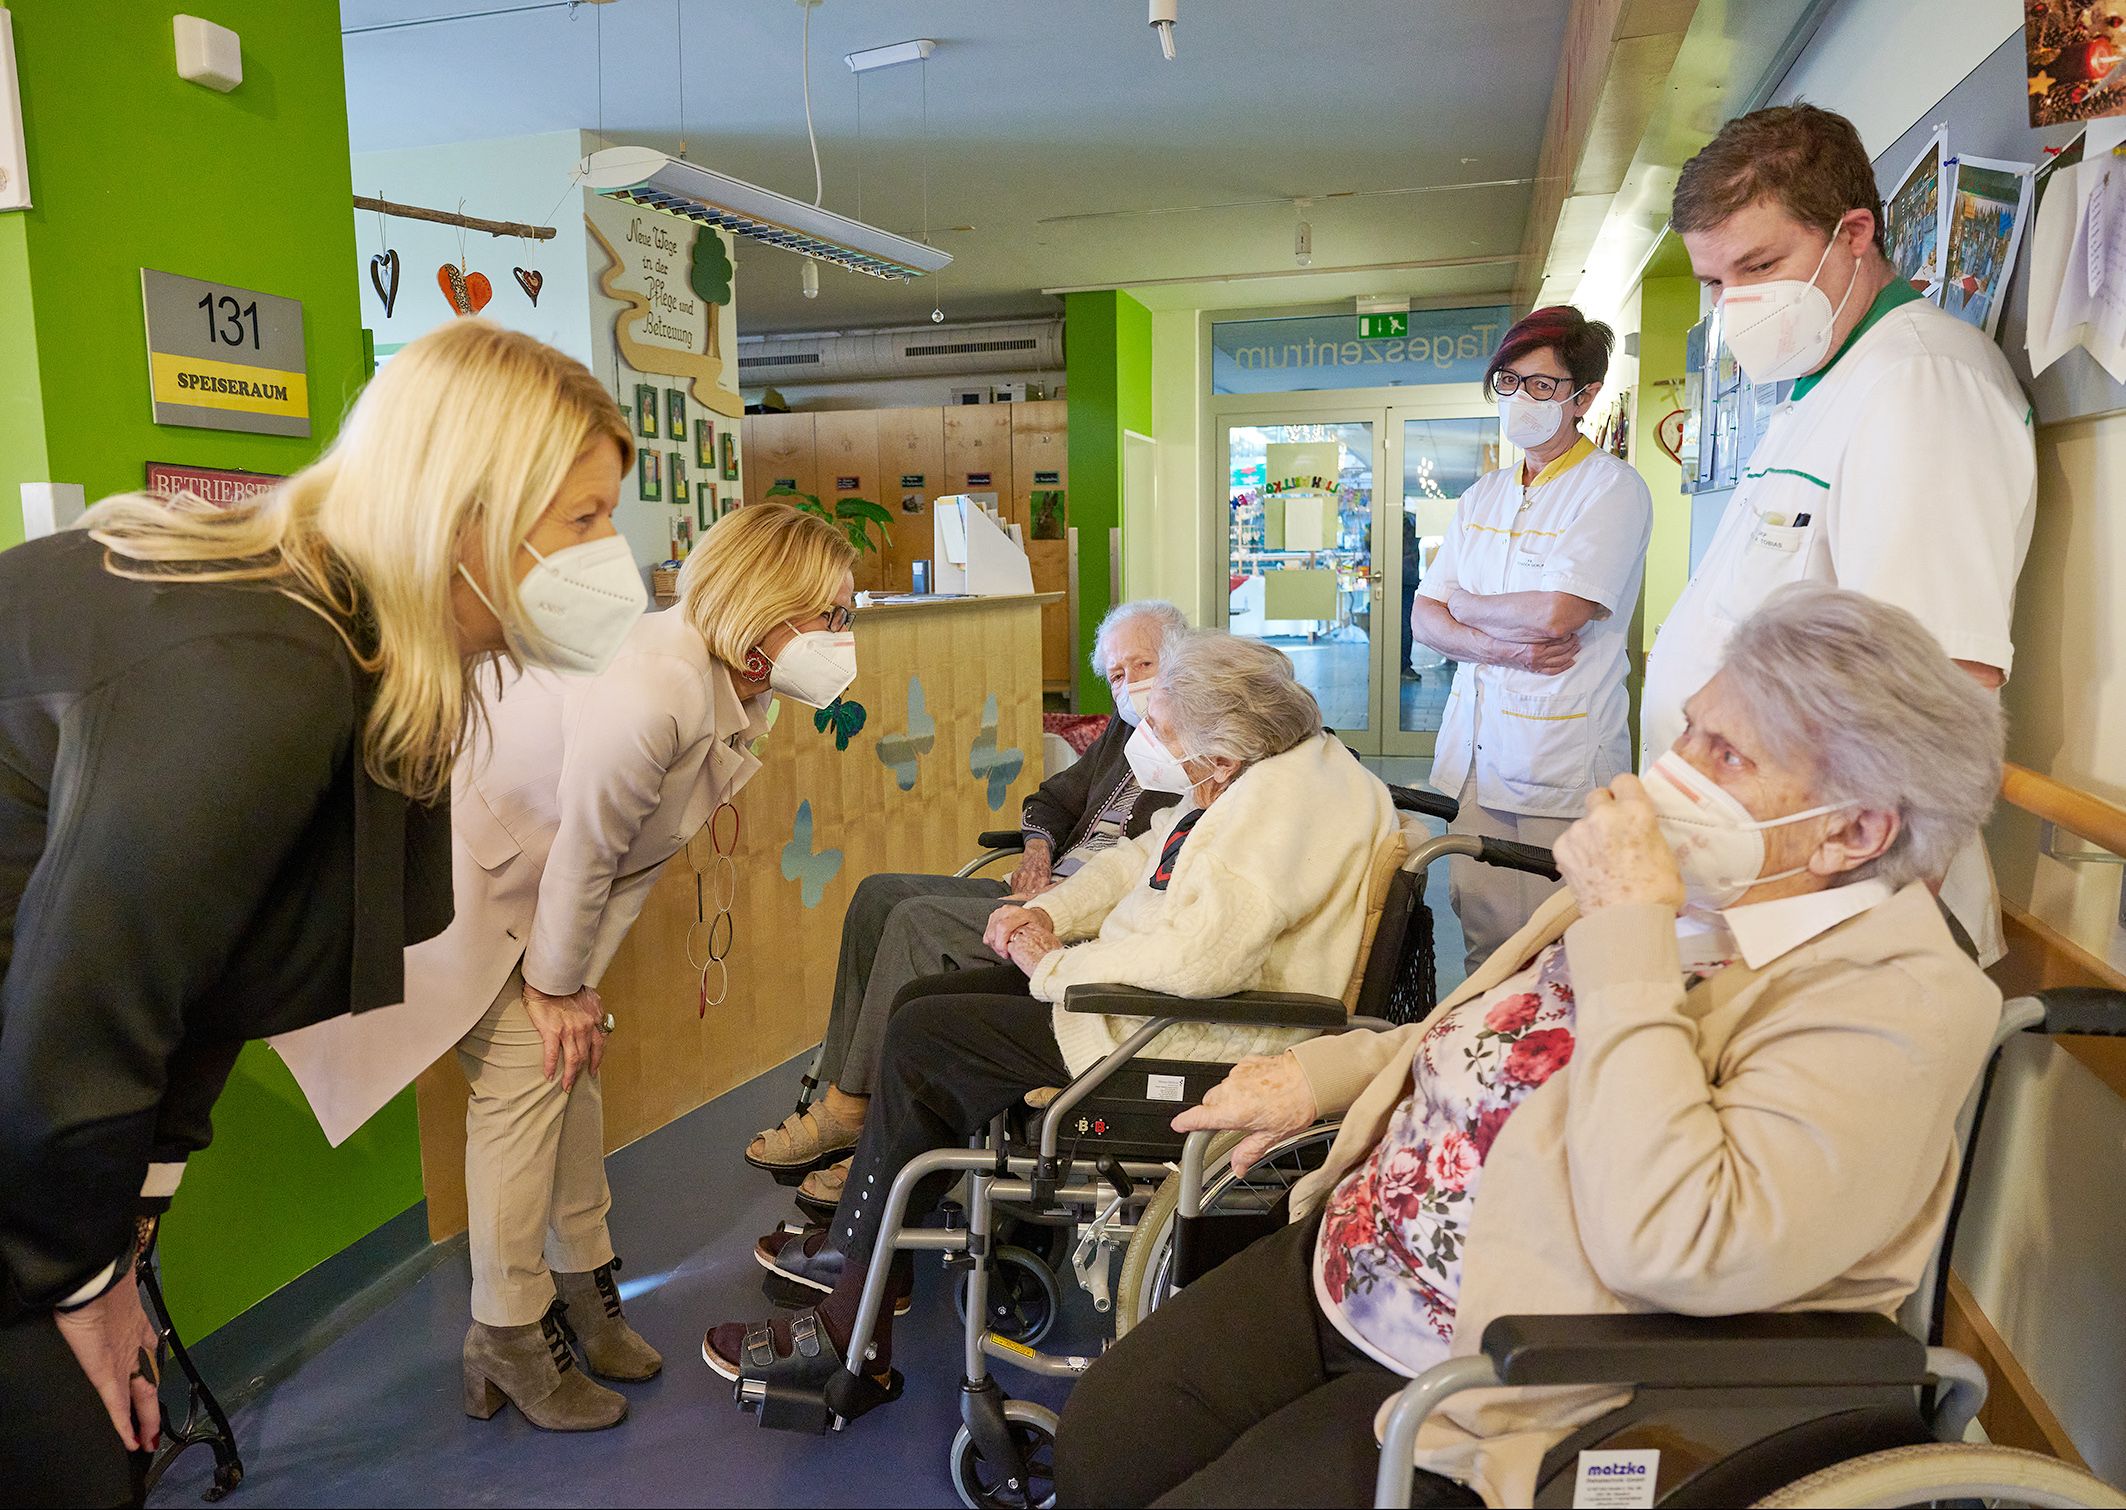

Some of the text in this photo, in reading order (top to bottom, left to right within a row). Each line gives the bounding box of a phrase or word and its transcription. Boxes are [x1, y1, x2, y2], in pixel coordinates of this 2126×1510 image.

[626, 217, 677, 257] Neue Wege
[642, 256, 668, 275] in der
[644, 275, 694, 316] Pflege und
[198, 292, 260, 350] 131
[642, 310, 693, 350] Betreuung
[177, 372, 288, 401] SPEISERAUM
[1587, 1461, 1646, 1476] matzka
